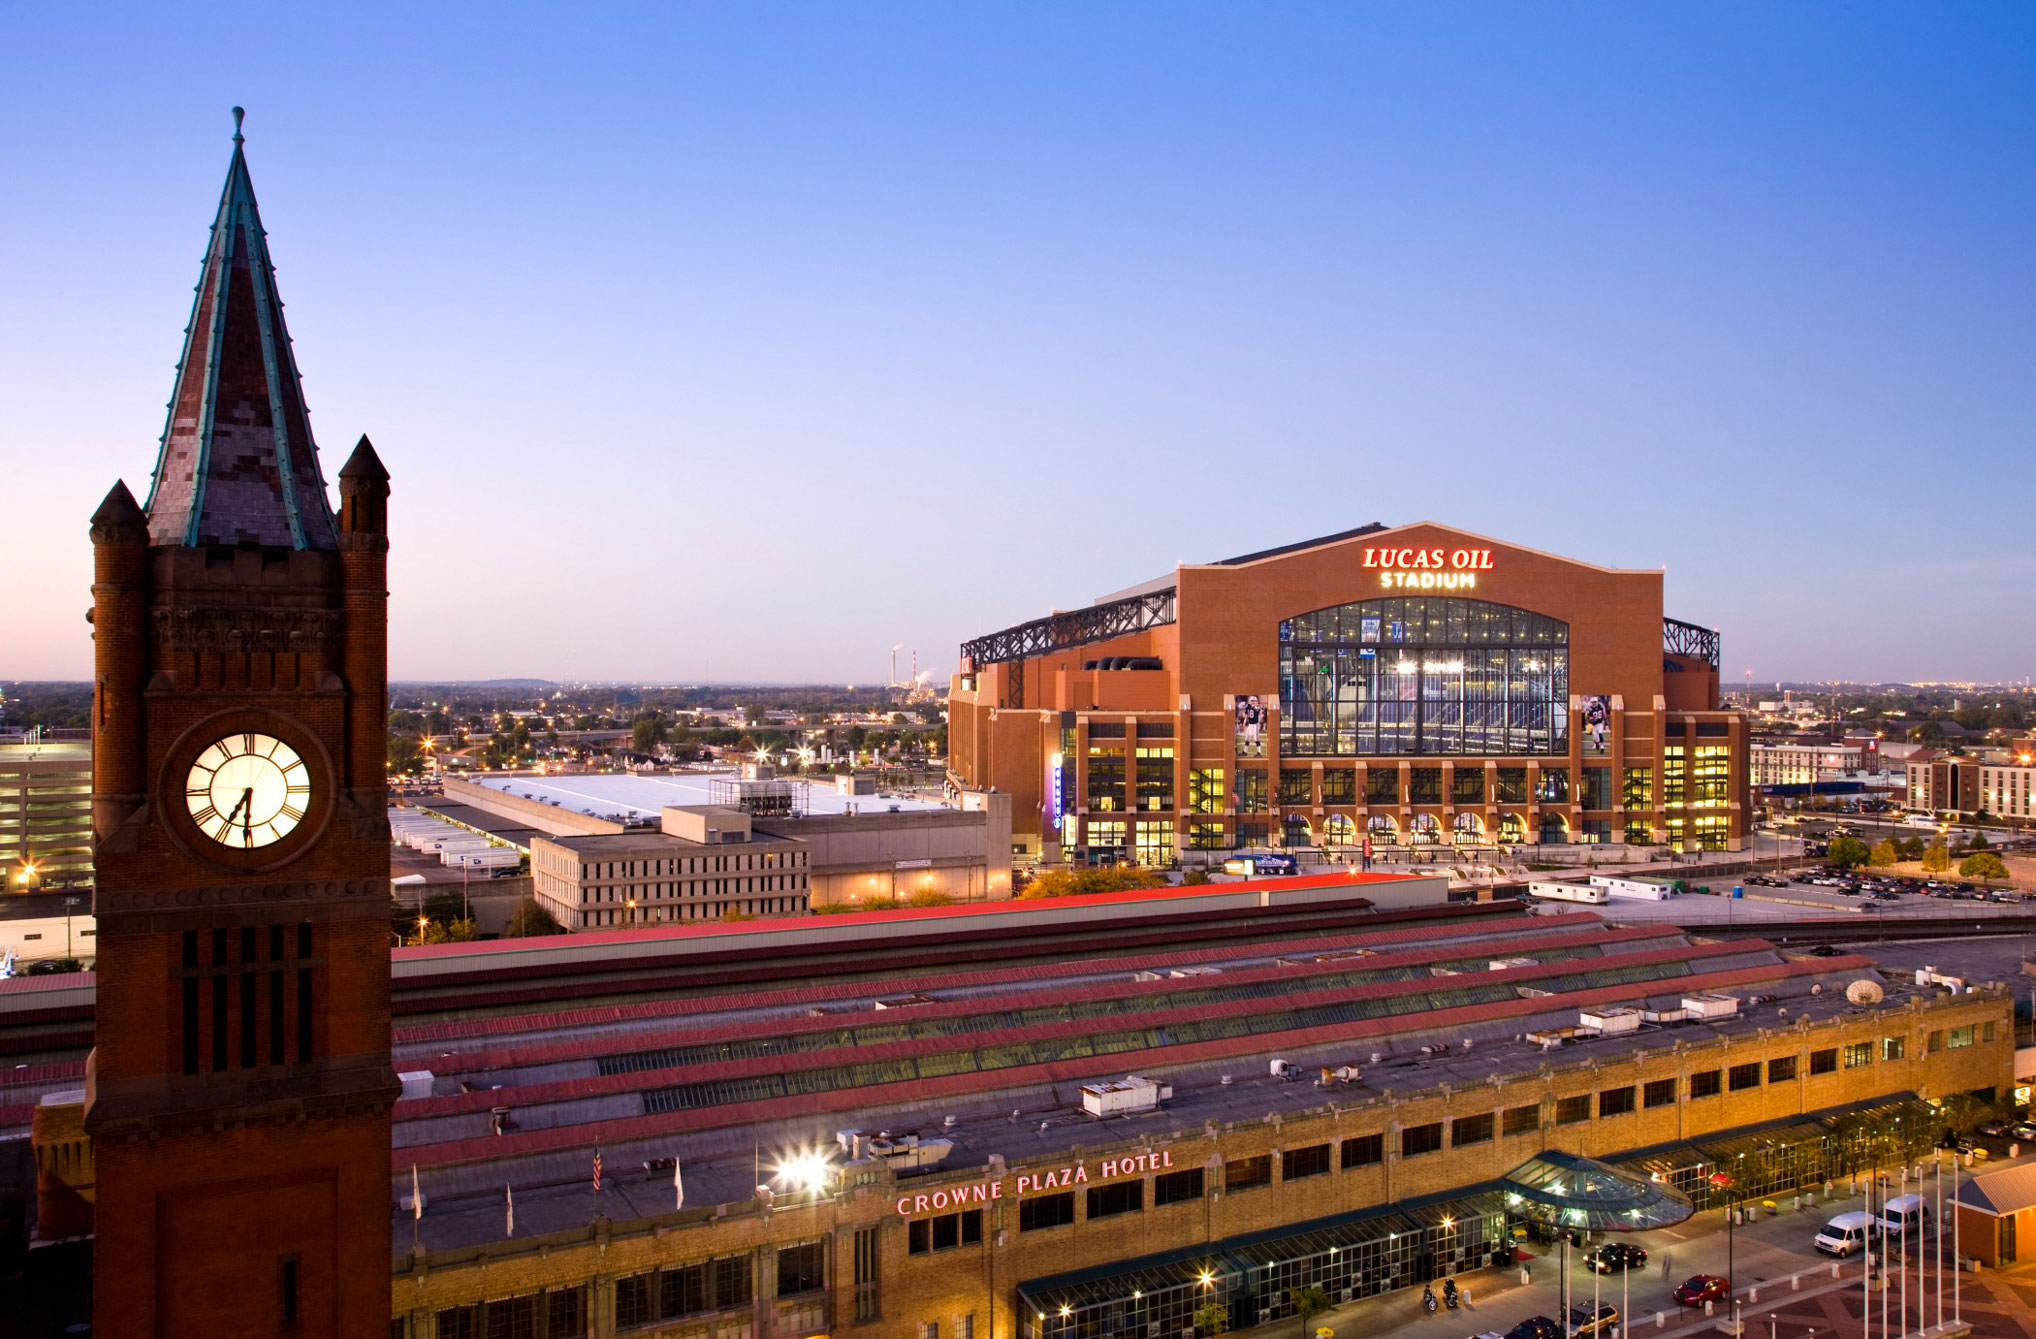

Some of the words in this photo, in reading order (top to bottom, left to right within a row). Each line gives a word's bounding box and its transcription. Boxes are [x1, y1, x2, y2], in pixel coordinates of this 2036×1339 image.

[1362, 548, 1445, 569] LUCAS
[1451, 549, 1494, 569] OIL
[1380, 572, 1476, 588] STADIUM
[897, 1182, 1003, 1216] CROWNE
[1017, 1166, 1088, 1193] PLAZA
[1102, 1151, 1173, 1178] HOTEL
